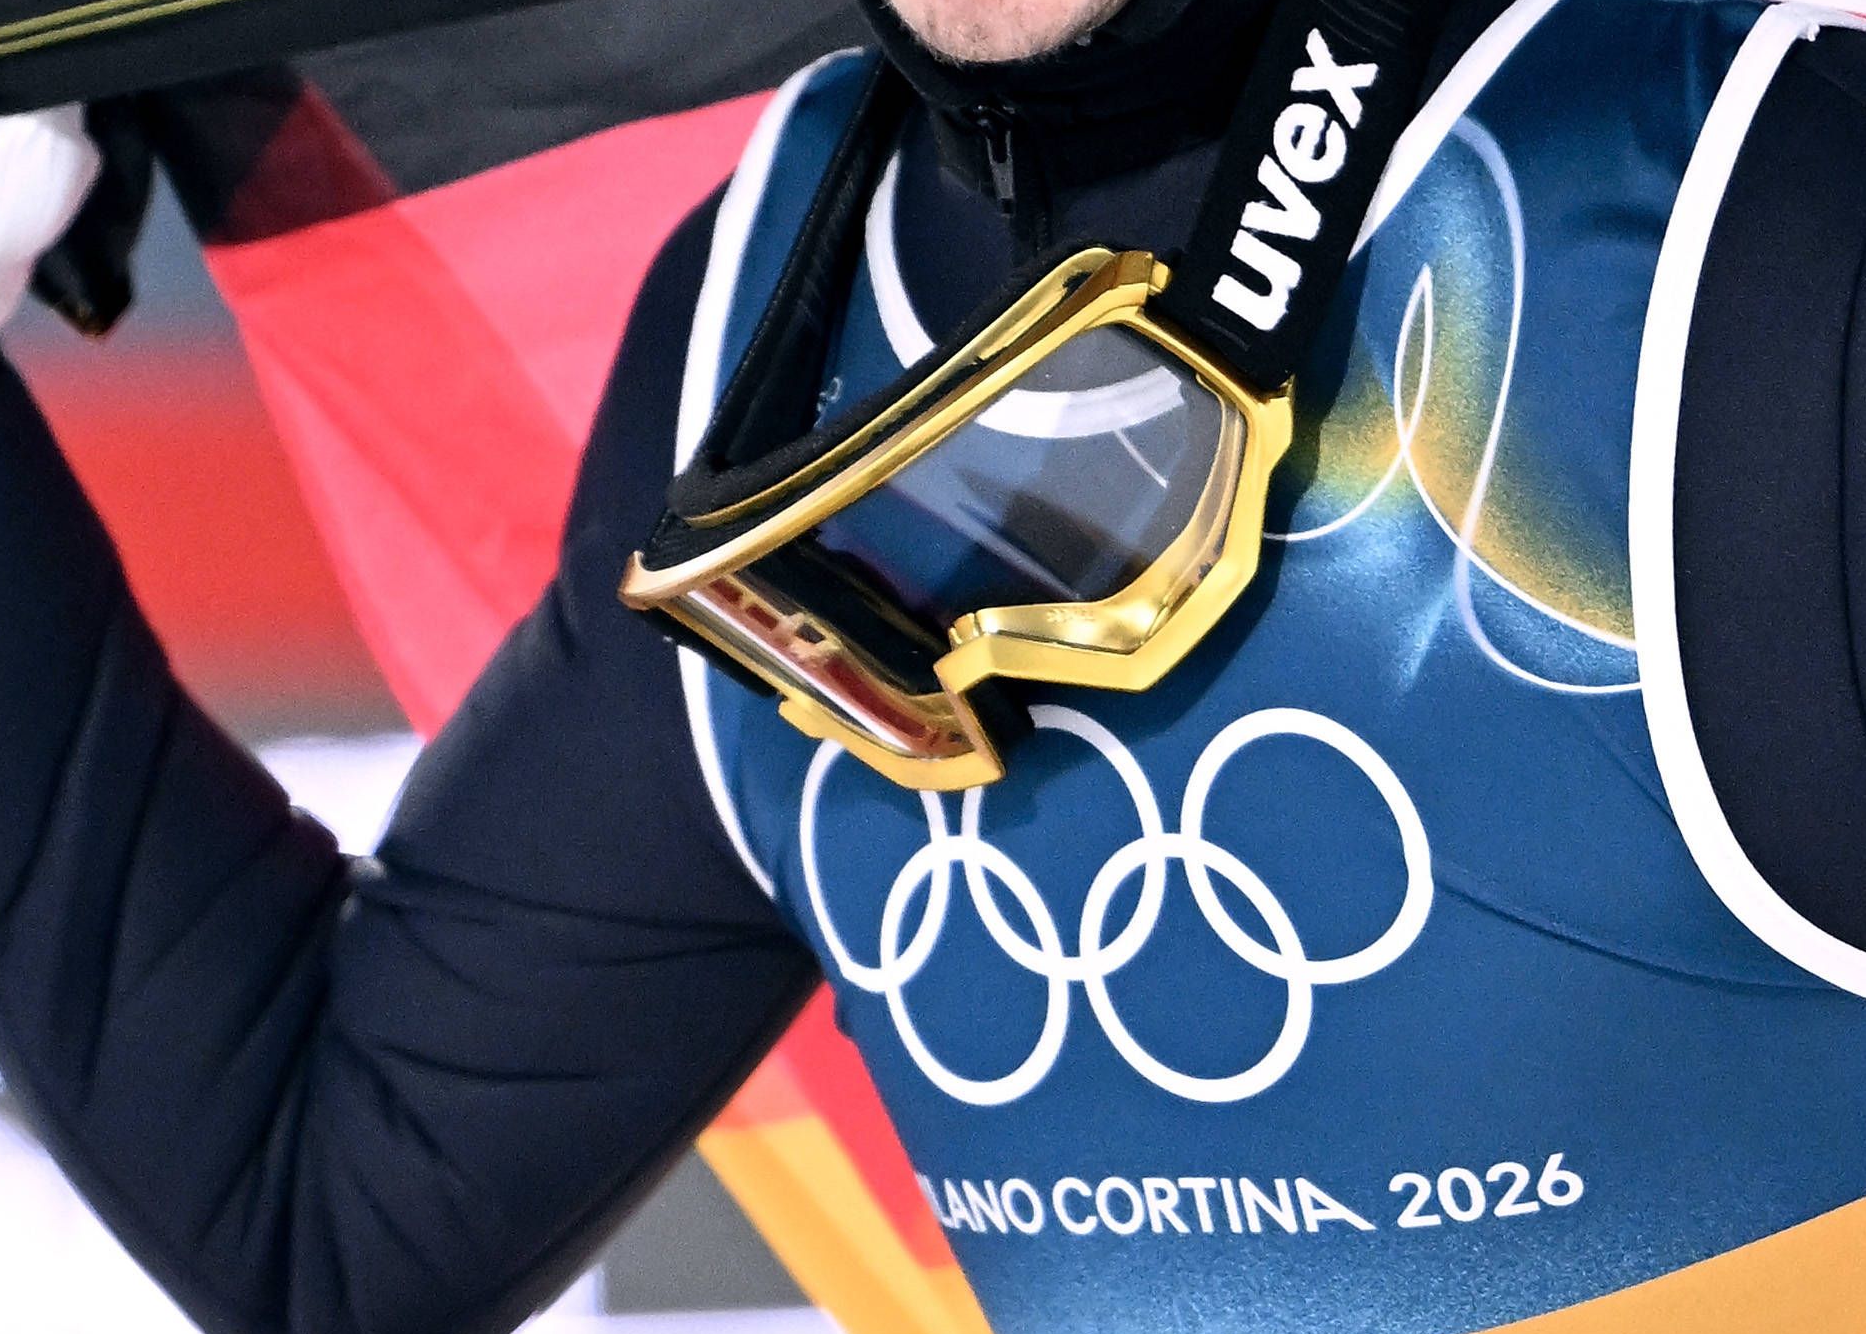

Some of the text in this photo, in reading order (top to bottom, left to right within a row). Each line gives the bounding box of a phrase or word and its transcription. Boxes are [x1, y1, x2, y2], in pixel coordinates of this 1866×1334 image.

[1211, 28, 1379, 331] uvex
[1052, 1177, 1376, 1235] CORTINA
[1388, 1153, 1584, 1229] 2026
